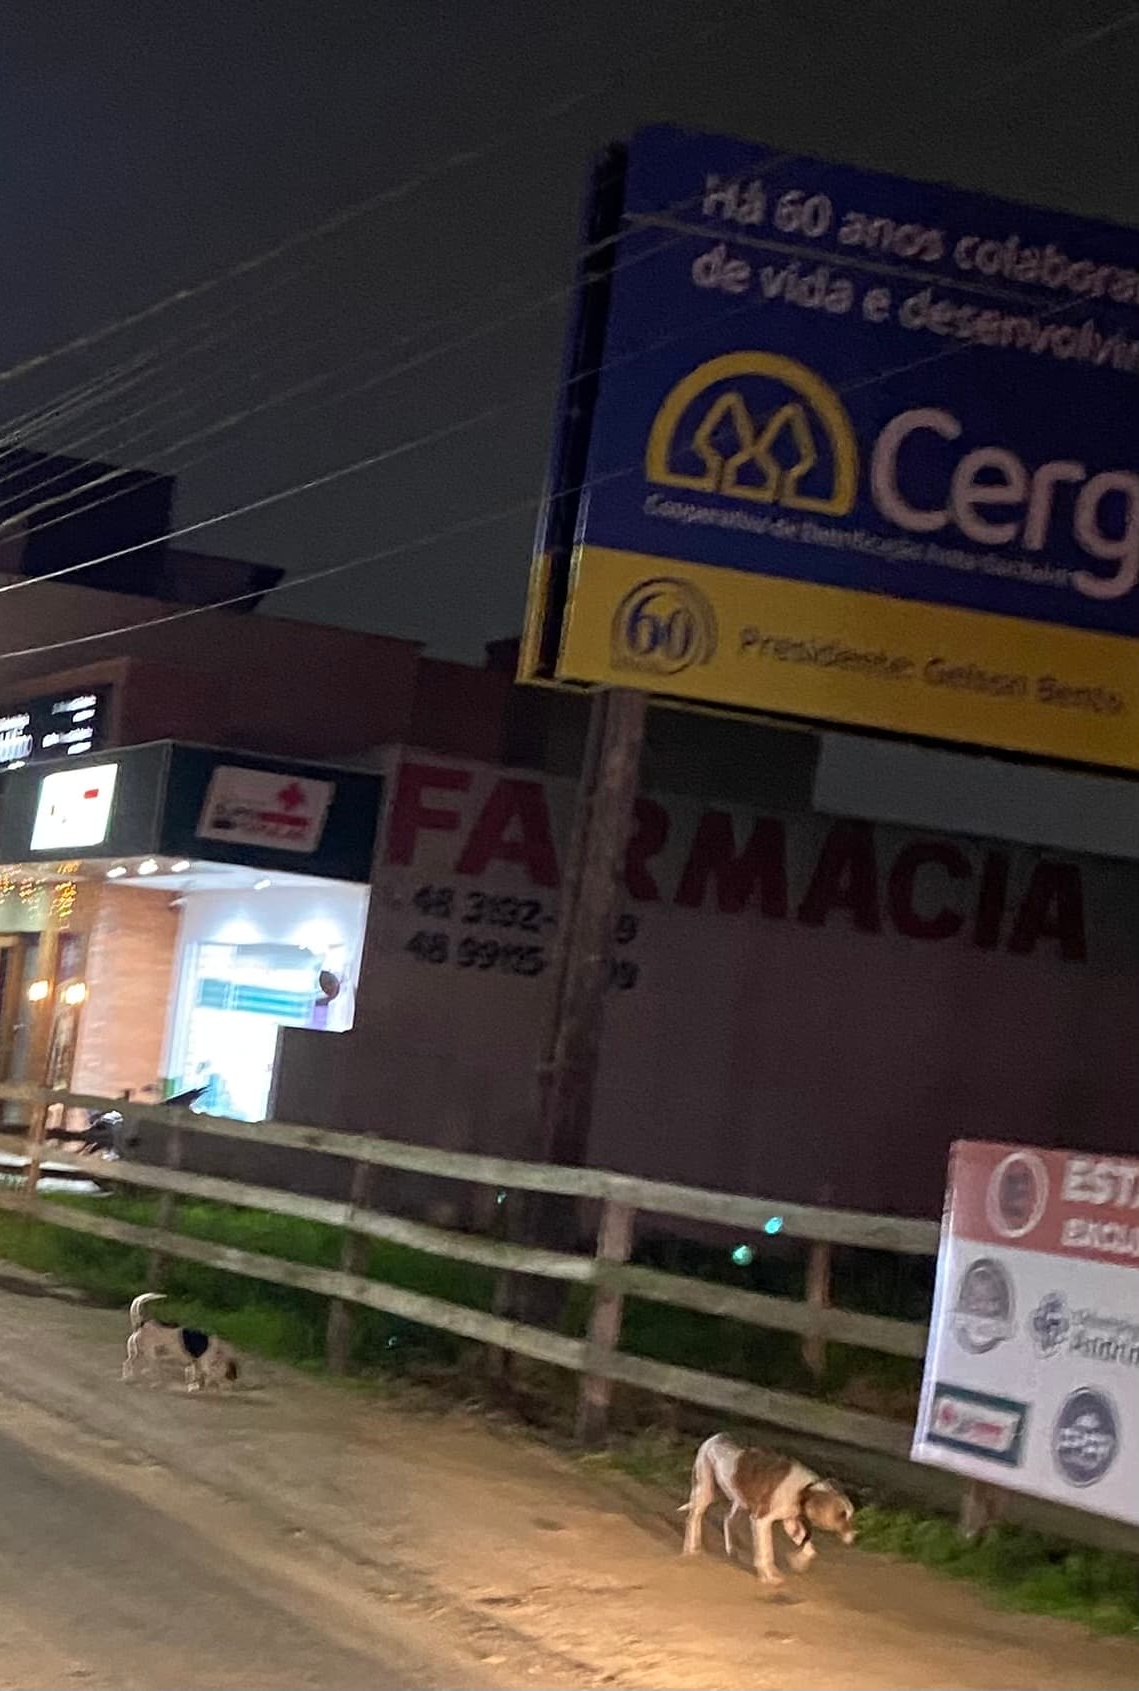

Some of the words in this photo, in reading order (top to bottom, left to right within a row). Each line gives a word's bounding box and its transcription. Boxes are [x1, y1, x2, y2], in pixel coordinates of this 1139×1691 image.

[702, 174, 767, 226] Há
[774, 189, 833, 239] 60
[837, 211, 947, 262] anos
[692, 243, 752, 294] de
[760, 261, 854, 315] vida
[862, 287, 892, 324] e
[869, 405, 1139, 600] Cerg
[627, 590, 699, 661] 60
[383, 762, 1088, 962] FARMACIA
[1062, 1158, 1139, 1210] EST
